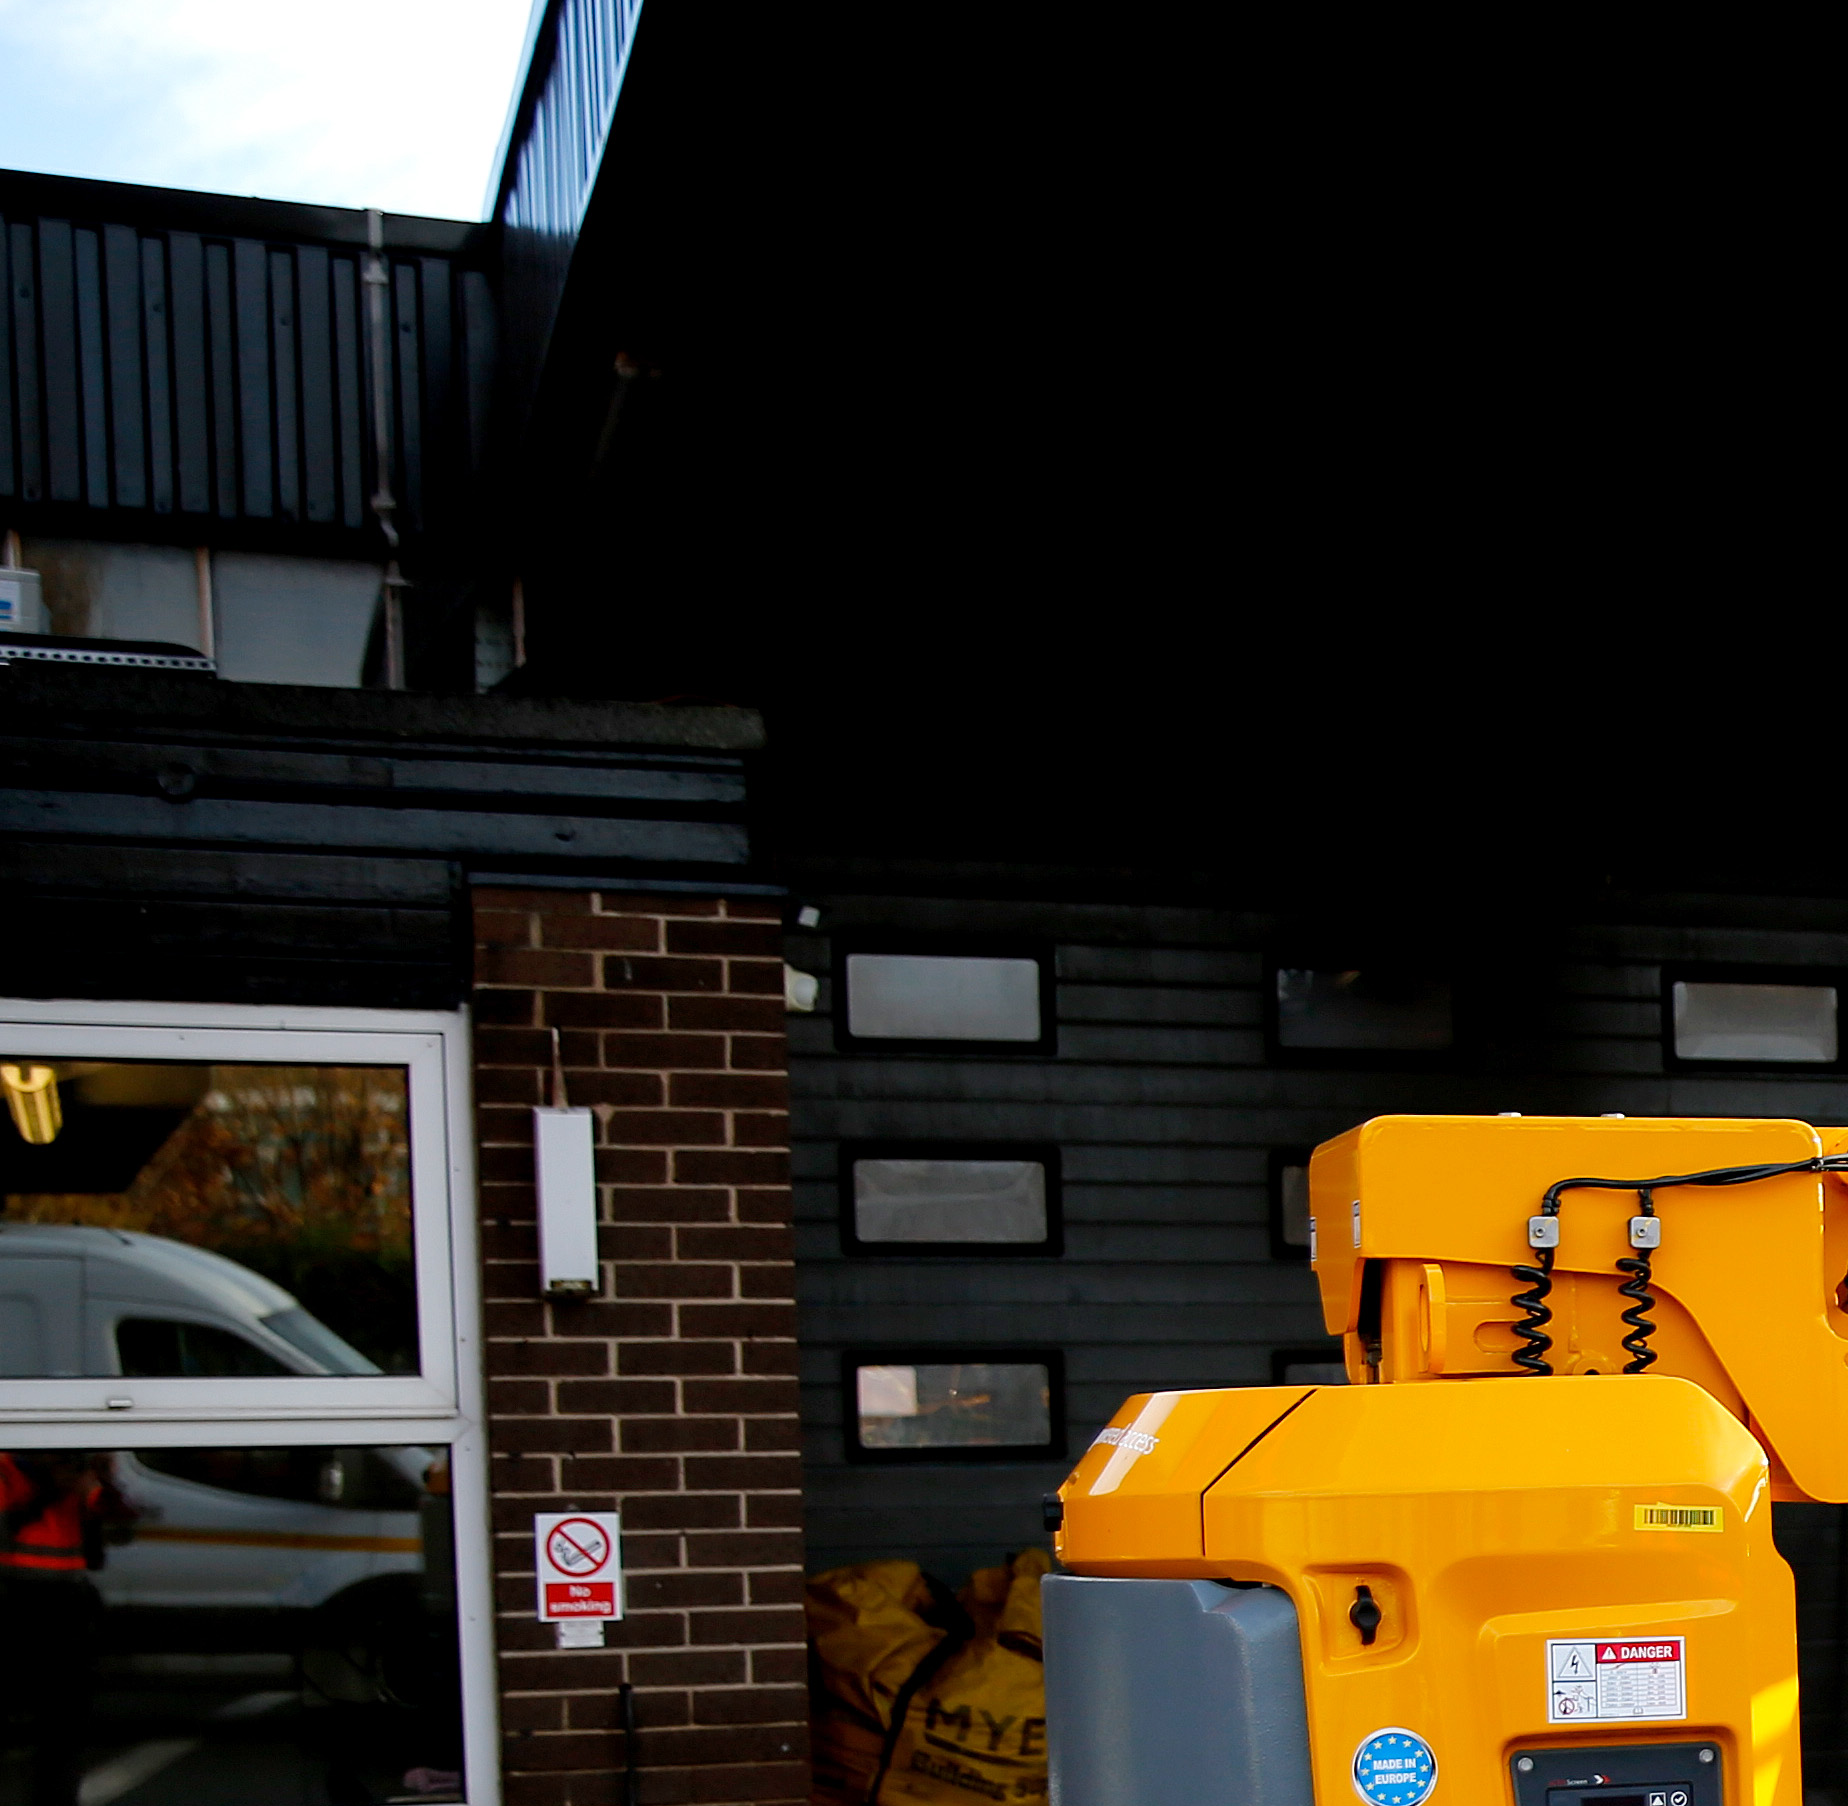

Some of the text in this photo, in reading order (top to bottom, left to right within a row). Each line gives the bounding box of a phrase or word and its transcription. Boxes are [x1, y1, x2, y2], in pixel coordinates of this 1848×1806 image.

[569, 1585, 592, 1597] No
[549, 1600, 612, 1614] smoking
[1620, 1645, 1673, 1659] DANGER
[1373, 1758, 1417, 1771] MADE IN
[1374, 1772, 1417, 1785] EUROPE
